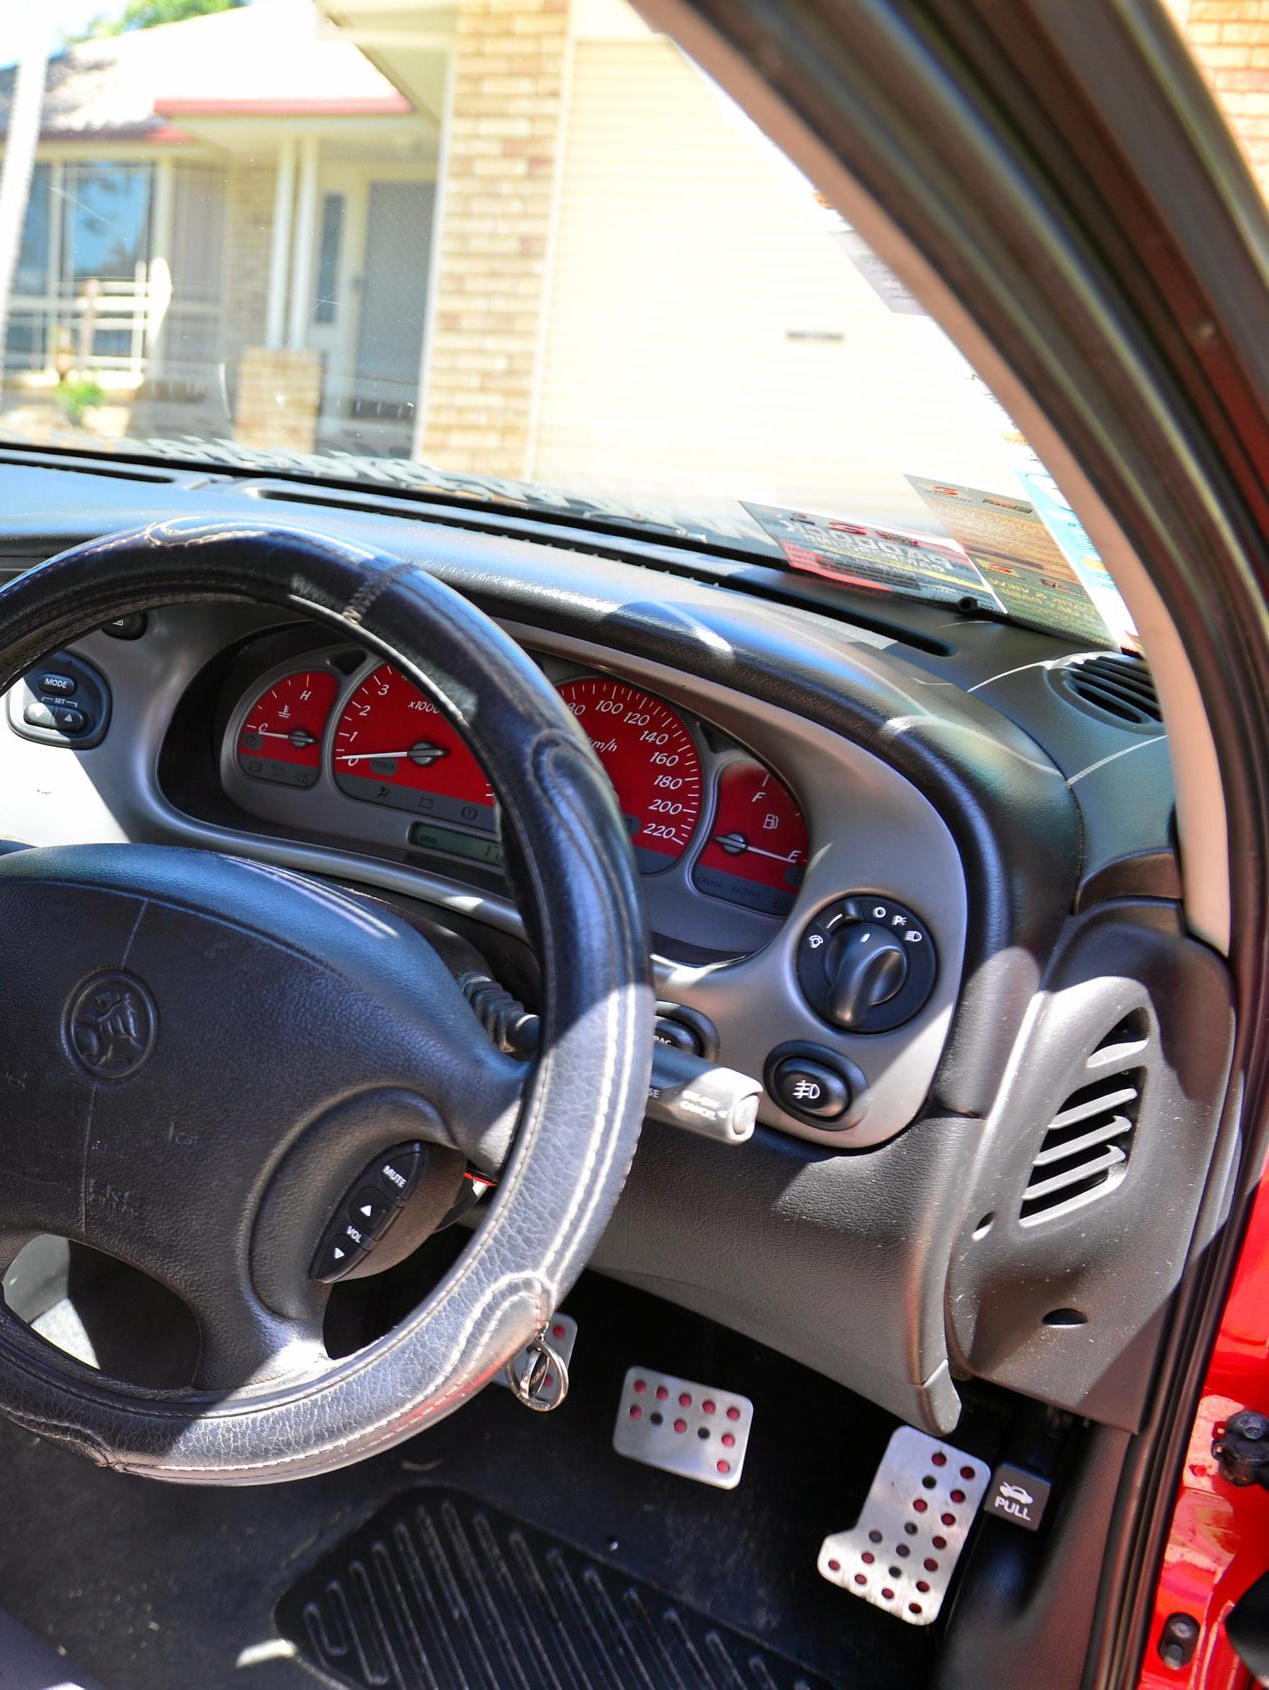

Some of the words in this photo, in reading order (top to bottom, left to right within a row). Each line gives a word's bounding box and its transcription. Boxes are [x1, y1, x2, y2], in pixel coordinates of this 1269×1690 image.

[44, 678, 67, 689] MODE
[378, 685, 389, 696] 3
[299, 690, 311, 700] H
[359, 705, 371, 716] 2
[595, 700, 623, 714] 100
[624, 712, 650, 726] 120
[259, 722, 269, 734] C
[349, 731, 358, 742] 1
[639, 730, 669, 745] 140
[649, 752, 679, 767] 160
[653, 774, 683, 789] 180
[751, 792, 766, 802] F
[649, 799, 682, 815] 200
[643, 823, 676, 839] 220
[787, 850, 802, 862] E
[382, 1165, 407, 1188] MUTE
[346, 1226, 363, 1243] VOL
[994, 1495, 1032, 1521] PULL
